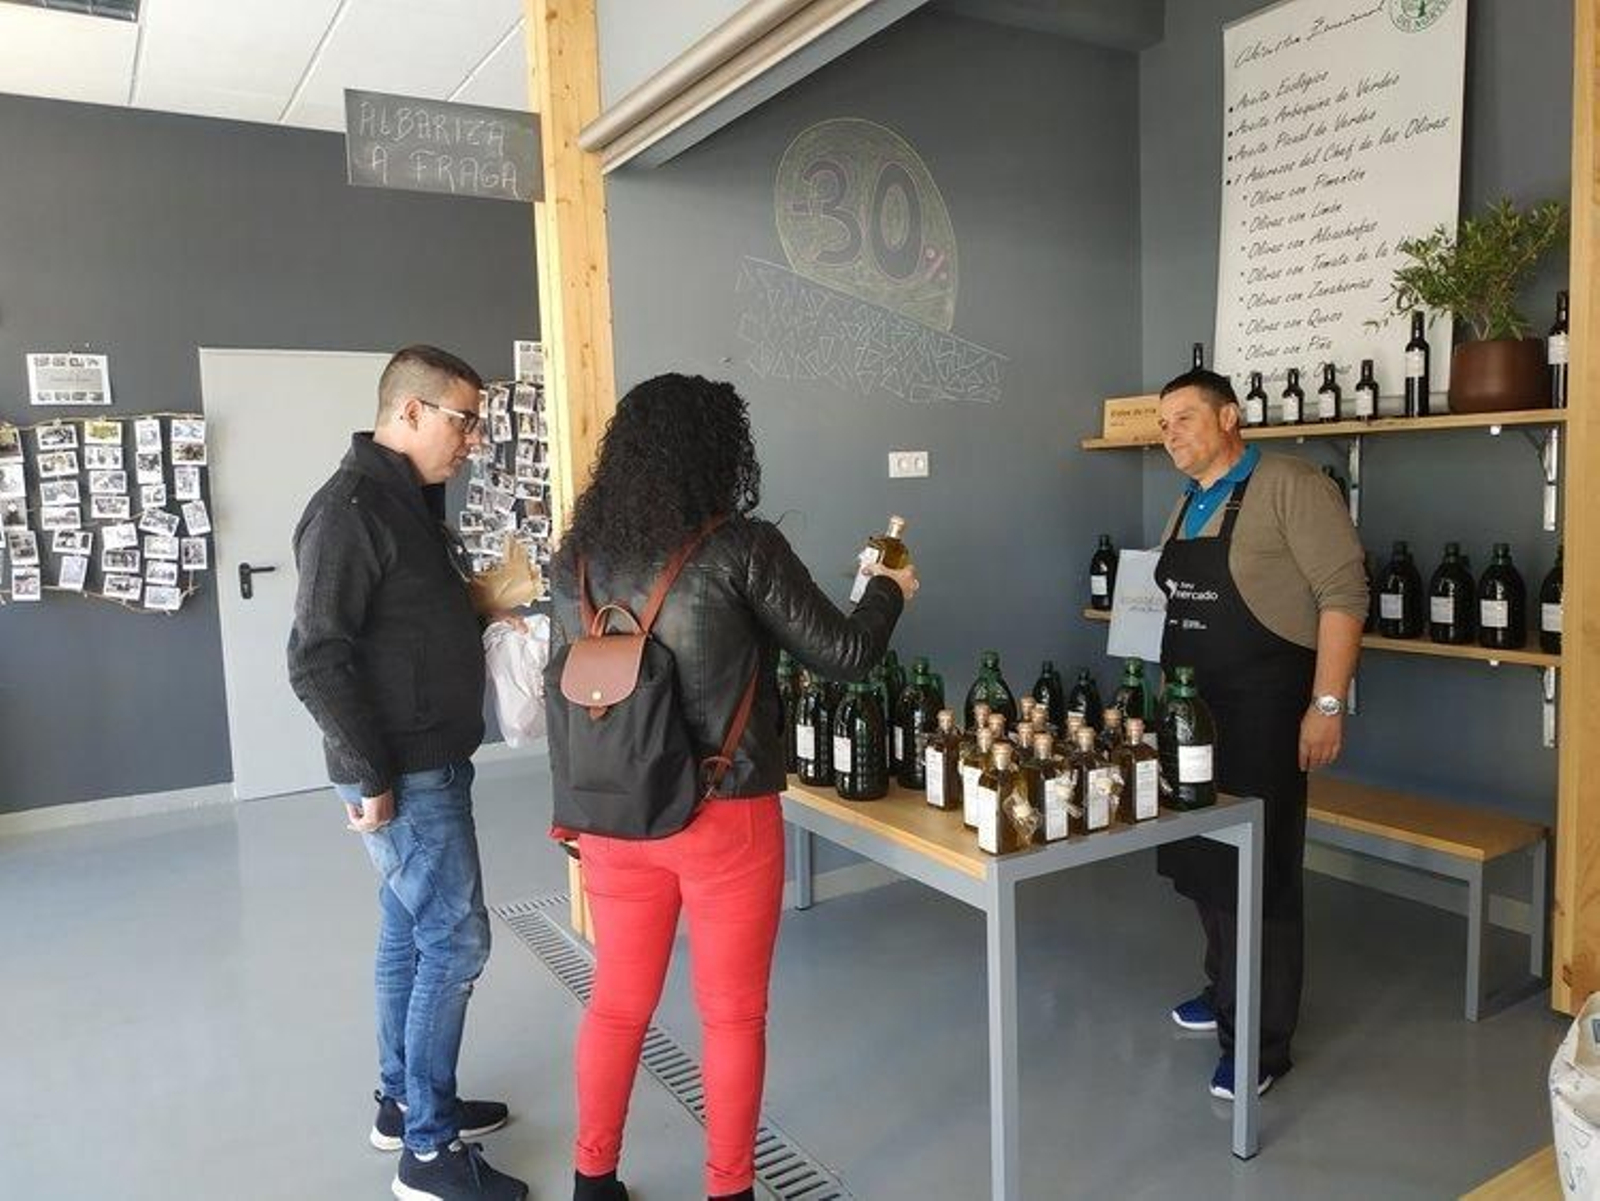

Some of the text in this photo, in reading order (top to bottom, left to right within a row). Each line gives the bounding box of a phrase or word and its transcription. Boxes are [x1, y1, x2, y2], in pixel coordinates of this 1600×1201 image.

[358, 101, 505, 155] ALBARIZA
[371, 144, 521, 200] A FRAGA
